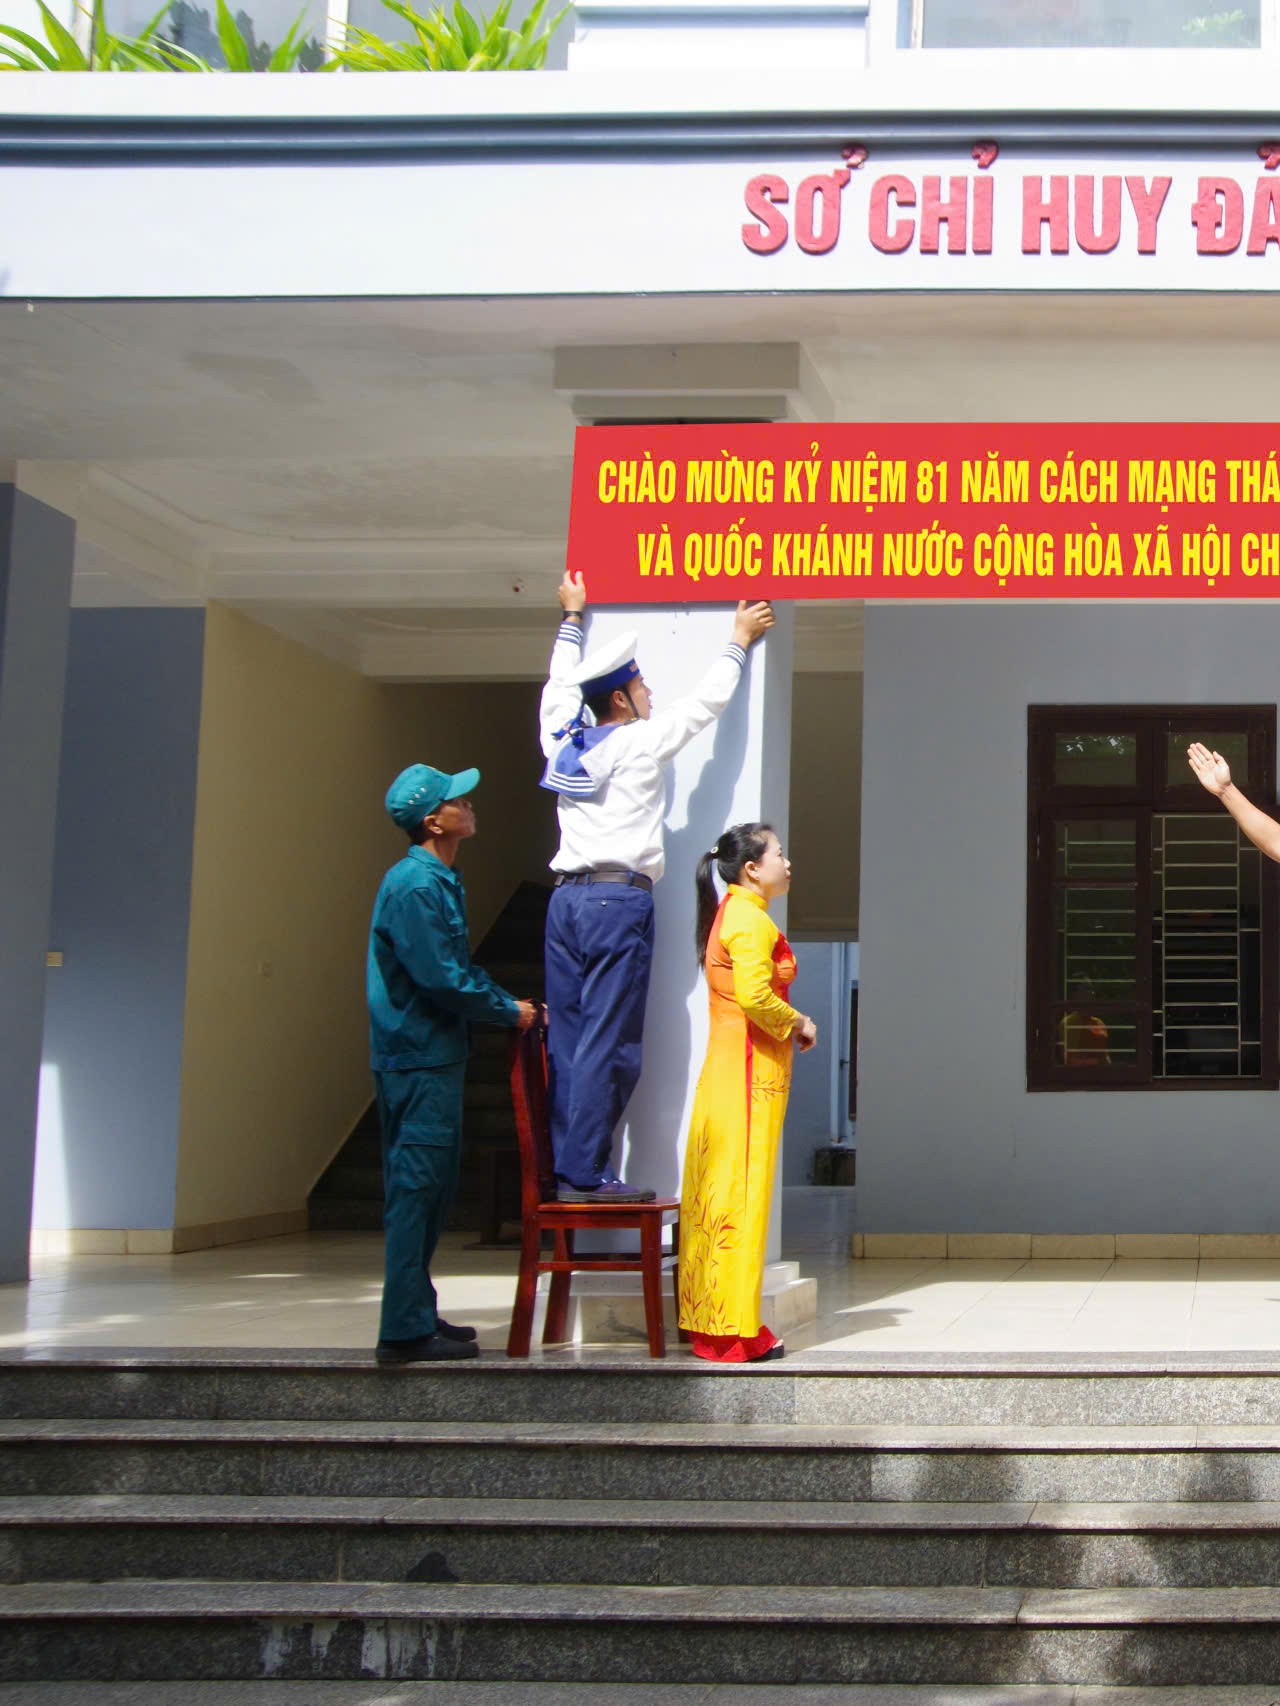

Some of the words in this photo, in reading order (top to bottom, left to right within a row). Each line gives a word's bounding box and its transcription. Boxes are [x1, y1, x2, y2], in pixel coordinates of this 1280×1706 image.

[742, 144, 869, 255] SỞ
[868, 140, 998, 255] CHỈ
[1021, 176, 1172, 254] HUY
[598, 451, 677, 504] CHÀO
[685, 449, 775, 504] MỪNG
[783, 441, 822, 503] KỶ
[830, 450, 907, 513] NIỆM
[916, 460, 948, 504] 81
[960, 450, 1030, 503] NĂM
[1039, 450, 1118, 504] CÁCH
[1128, 459, 1216, 513] MẠNG
[637, 523, 674, 576] VÀ
[684, 517, 763, 582] QUỐC
[772, 523, 873, 576] KHÁNH
[882, 519, 964, 577] NƯỚC
[973, 523, 1054, 587] CỘNG
[1064, 522, 1124, 577] HÒA
[1132, 524, 1173, 576] XÃ
[1182, 523, 1231, 587] HỘI
